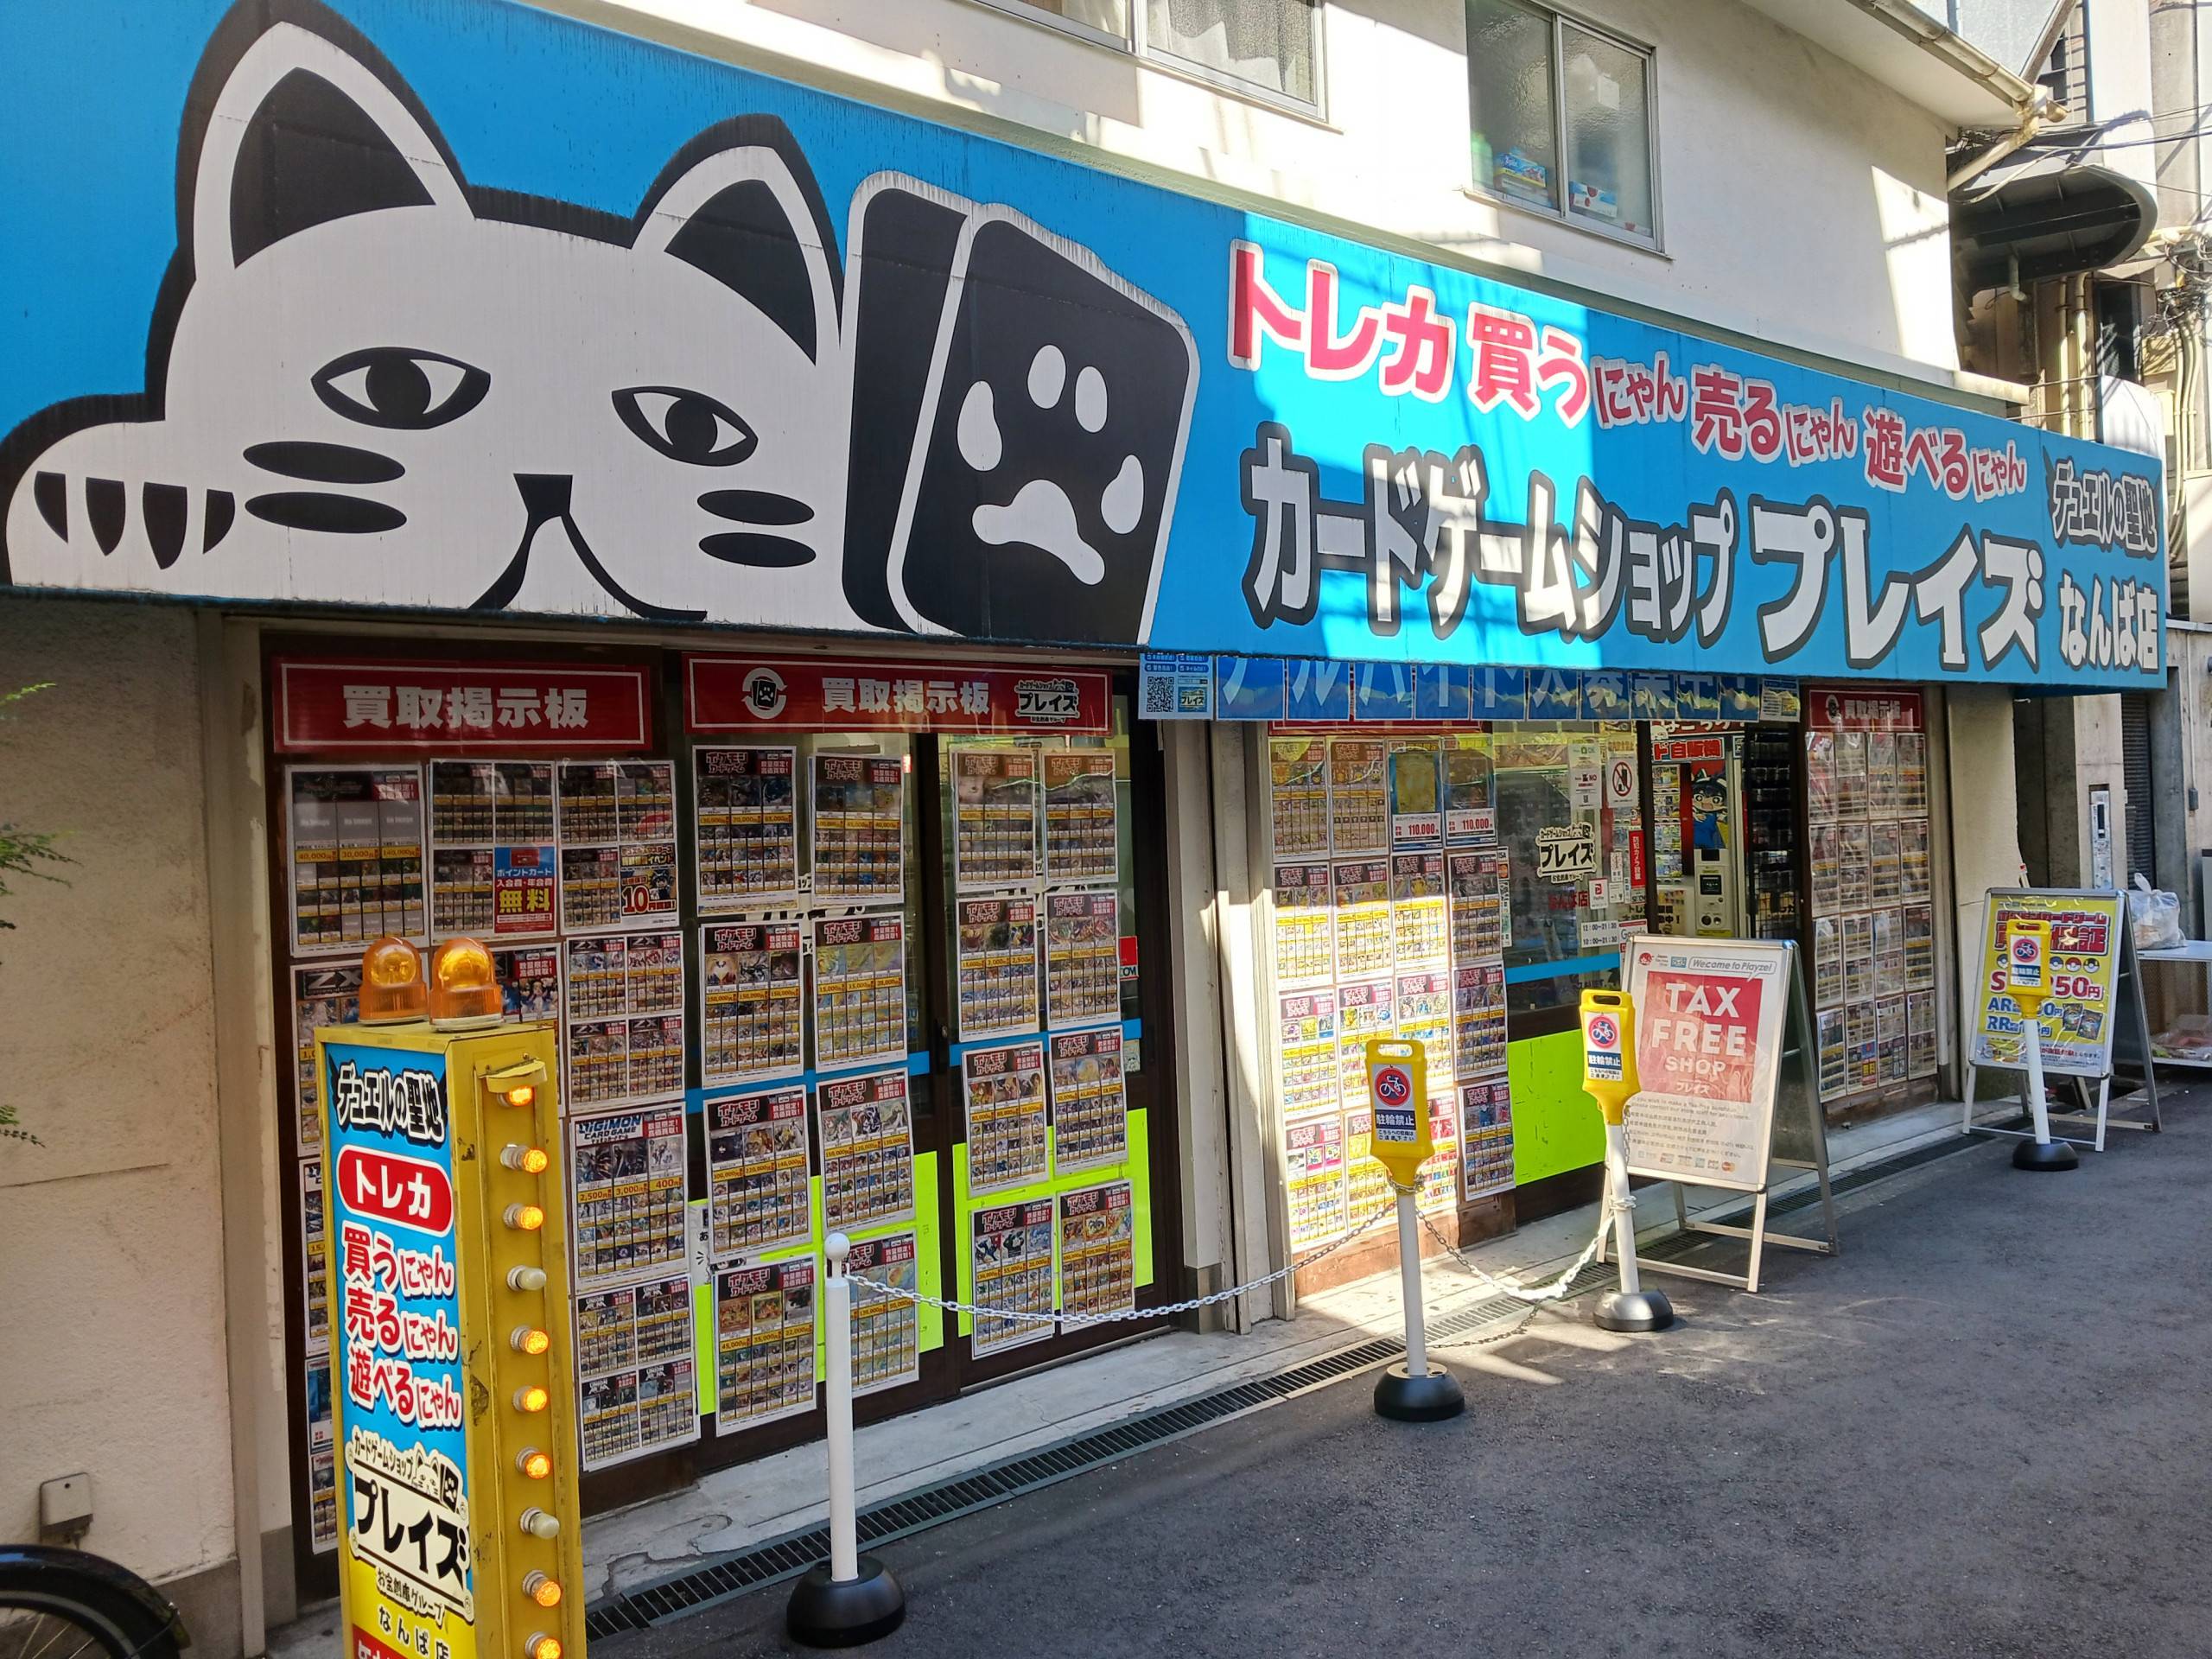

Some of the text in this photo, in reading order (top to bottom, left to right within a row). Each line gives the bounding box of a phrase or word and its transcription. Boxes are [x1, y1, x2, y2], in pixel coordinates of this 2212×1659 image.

[1230, 240, 2026, 502] トレカ 買うにゃん 売るにゃん 遊べるにゃん
[2052, 456, 2158, 558] デュエルの聖地
[1243, 423, 2045, 673] カードゲームショップ プレイズ
[2060, 569, 2159, 673] なんば店
[342, 684, 589, 729] 買取掲示板
[822, 677, 990, 715] 買取掲示板
[1020, 693, 1077, 711] プレイズ
[1181, 695, 1205, 705] プレイズ
[1845, 699, 1901, 720] 買取掲示板
[705, 751, 748, 765] ポケモン
[1541, 843, 1594, 868] プレイズ
[496, 868, 553, 877] ポイントカード
[499, 889, 551, 914] 無料
[714, 926, 757, 942] ポケモン
[823, 920, 862, 935] ポケモン
[1732, 962, 1741, 970] to
[1741, 963, 1772, 974] Playze!
[2050, 976, 2101, 998] 50円
[1664, 982, 1740, 1018] TAX
[1651, 1018, 1747, 1058] FREE
[1664, 1056, 1727, 1077] SHOP
[828, 1080, 867, 1098] ポケモン
[1675, 1080, 1711, 1095] プレイズ
[336, 1061, 445, 1143] デュエルの聖地
[718, 1098, 760, 1117] ポケモン
[1375, 1113, 1415, 1127] 駐輪禁止
[584, 1126, 637, 1140] CARD GAME
[355, 1159, 431, 1219] トレカ
[342, 1221, 454, 1296] 買うにゃん
[728, 1268, 771, 1287] ポケモン
[346, 1287, 458, 1361] 売るにゃん
[349, 1344, 462, 1427] 遊べるにゃん
[354, 1432, 414, 1481] カードゲームショップ
[354, 1474, 470, 1590] プレイズ
[378, 1606, 450, 1659] なんば店
